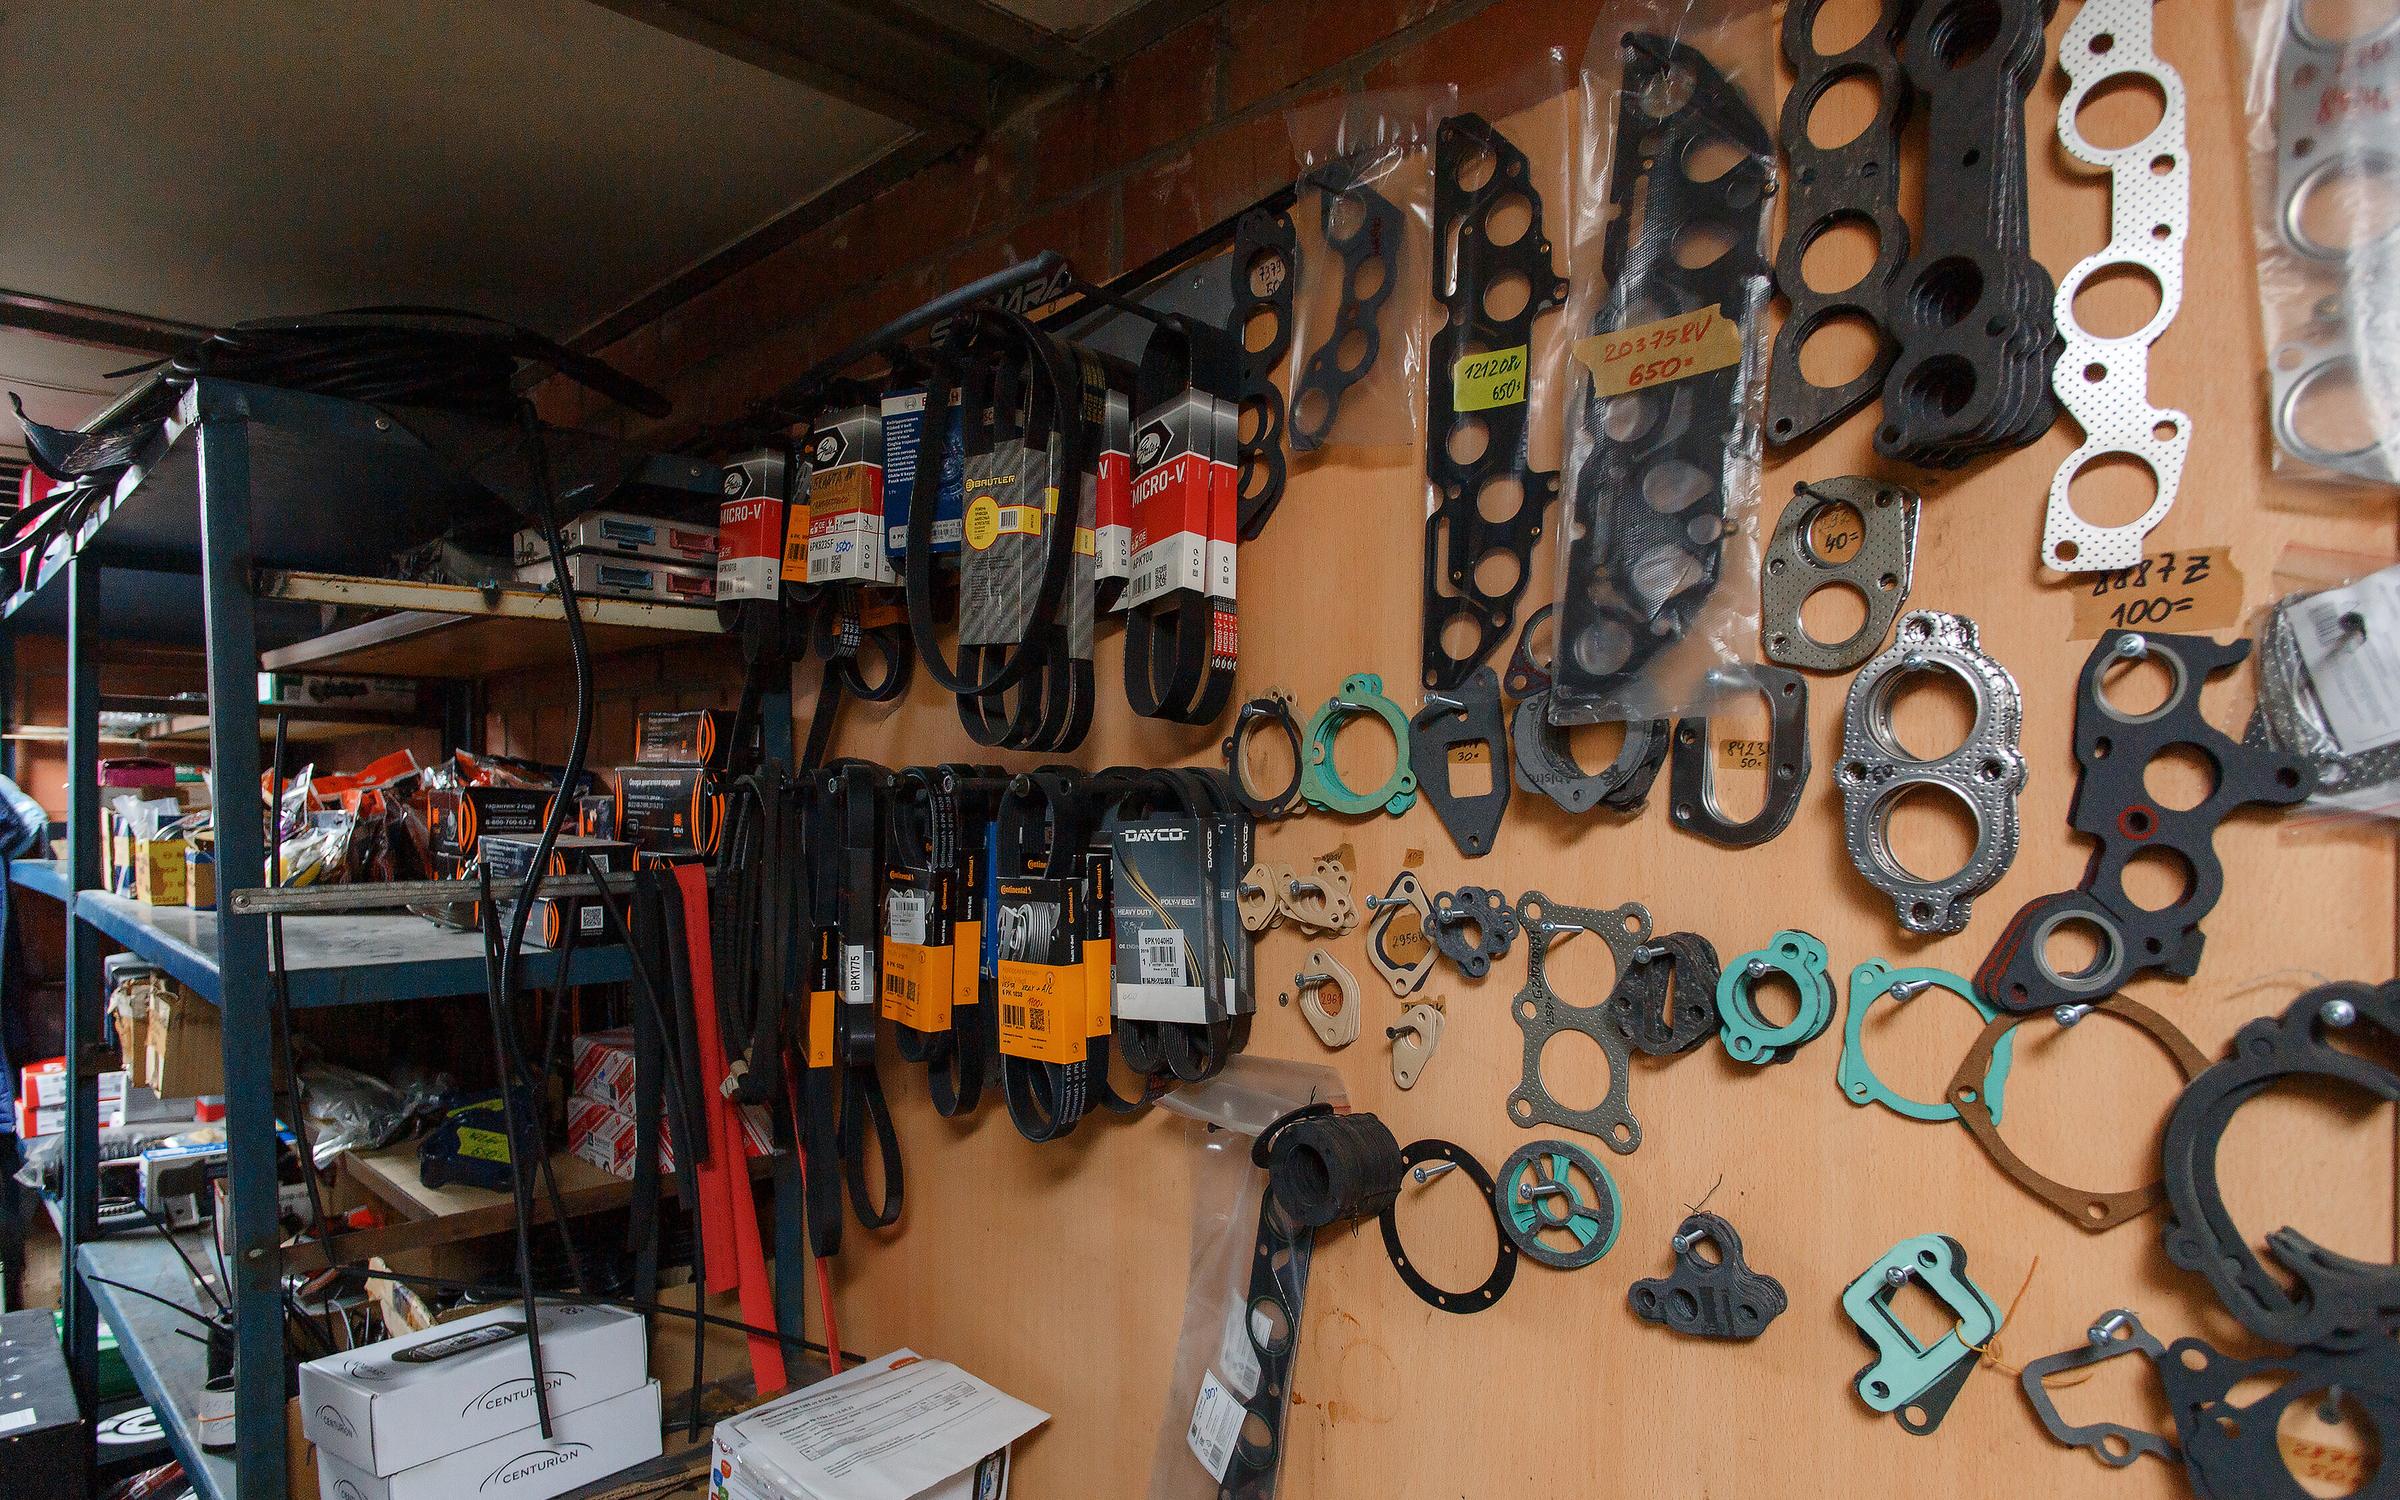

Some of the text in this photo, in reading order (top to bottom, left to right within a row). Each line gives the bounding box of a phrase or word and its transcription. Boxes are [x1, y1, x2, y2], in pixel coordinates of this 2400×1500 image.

[974, 475, 1016, 488] BAUTLER
[1132, 461, 1185, 508] MICRO-V
[2110, 597, 2194, 627] 100=
[1121, 827, 1188, 842] DAYCO
[1028, 859, 1048, 869] Contine
[1000, 884, 1028, 895] Continental
[851, 955, 860, 991] 6PK1775
[485, 1378, 562, 1411] CENTURON
[503, 1449, 578, 1485] CENTURION
